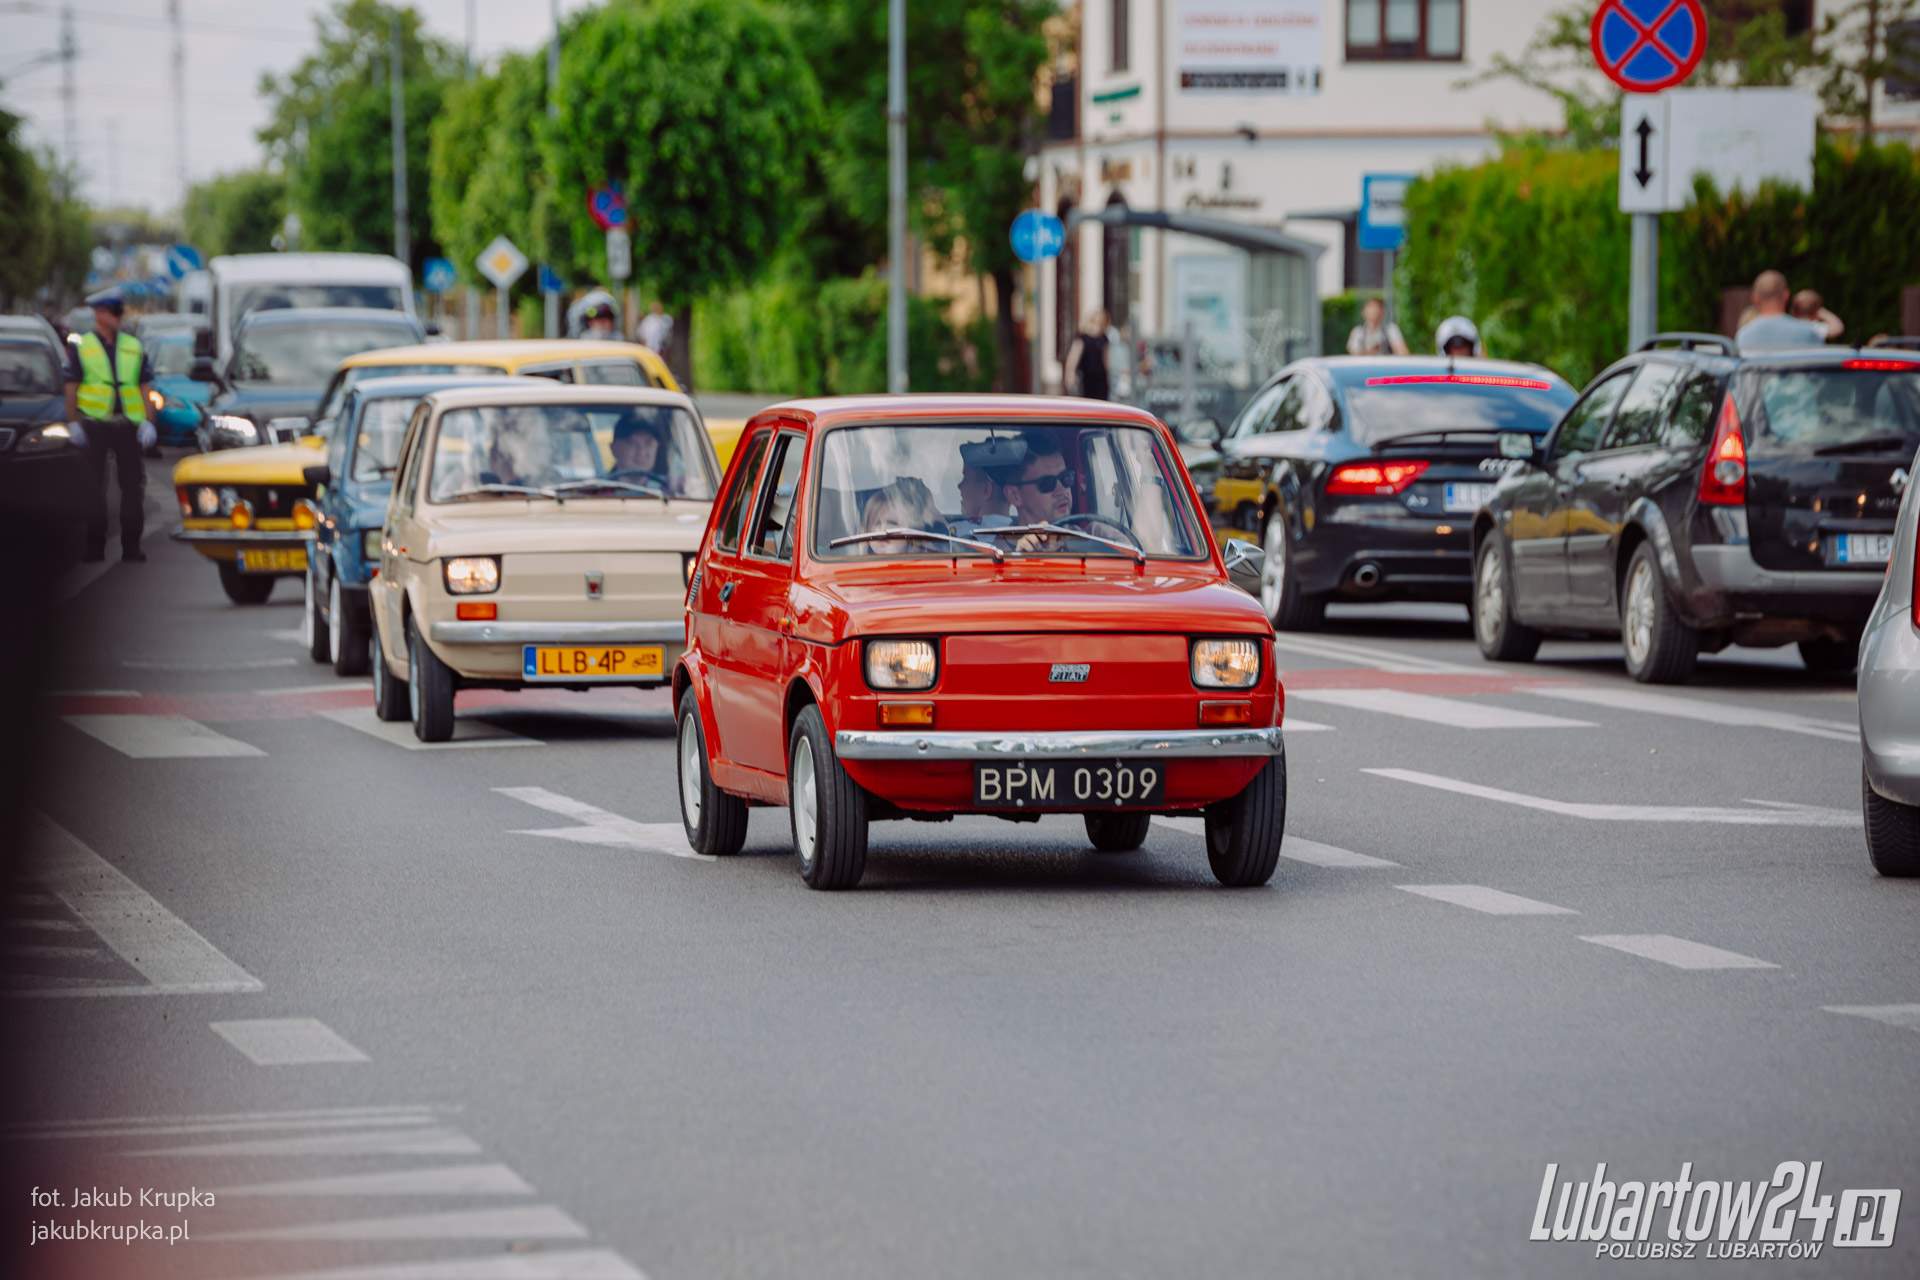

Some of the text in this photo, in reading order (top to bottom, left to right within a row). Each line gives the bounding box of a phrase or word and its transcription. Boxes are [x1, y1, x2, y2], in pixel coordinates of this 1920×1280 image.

[542, 650, 626, 673] LLB 4P
[980, 767, 1157, 801] BPM 0309
